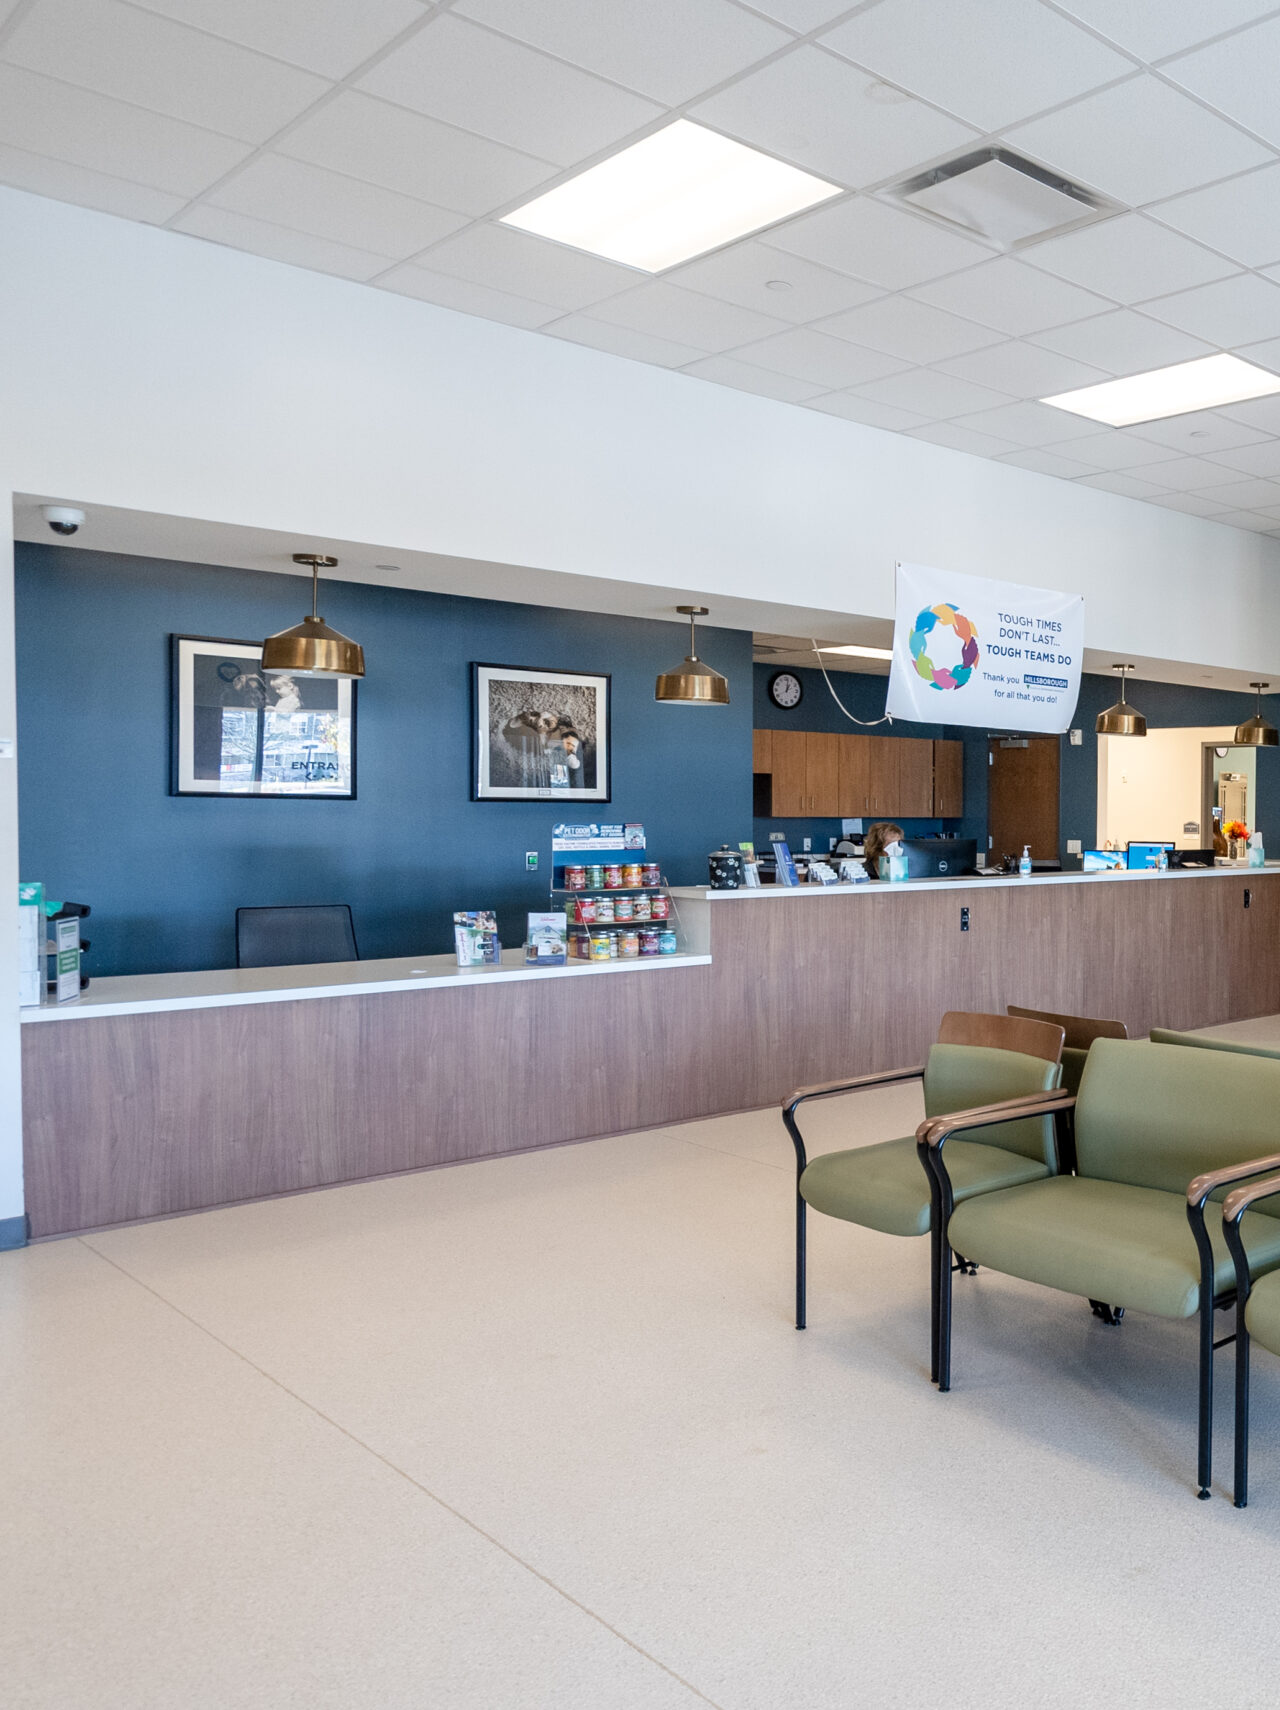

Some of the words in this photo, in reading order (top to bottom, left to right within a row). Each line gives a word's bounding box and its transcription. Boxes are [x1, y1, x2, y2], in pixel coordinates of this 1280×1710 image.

[998, 612, 1033, 627] TOUGH
[1036, 619, 1062, 632] TIMES
[1000, 627, 1030, 641] DON'T
[1032, 633, 1061, 647] LAST...
[986, 644, 1021, 658] TOUGH
[1024, 650, 1055, 663] TEAMS
[1058, 655, 1072, 666] DO
[983, 672, 1005, 682] Thank
[1024, 675, 1067, 688] HILLSBOROUGH
[994, 689, 1004, 698] for
[1006, 691, 1015, 699] all
[1016, 693, 1030, 701] that
[1032, 695, 1045, 703] you
[1046, 695, 1058, 704] do!
